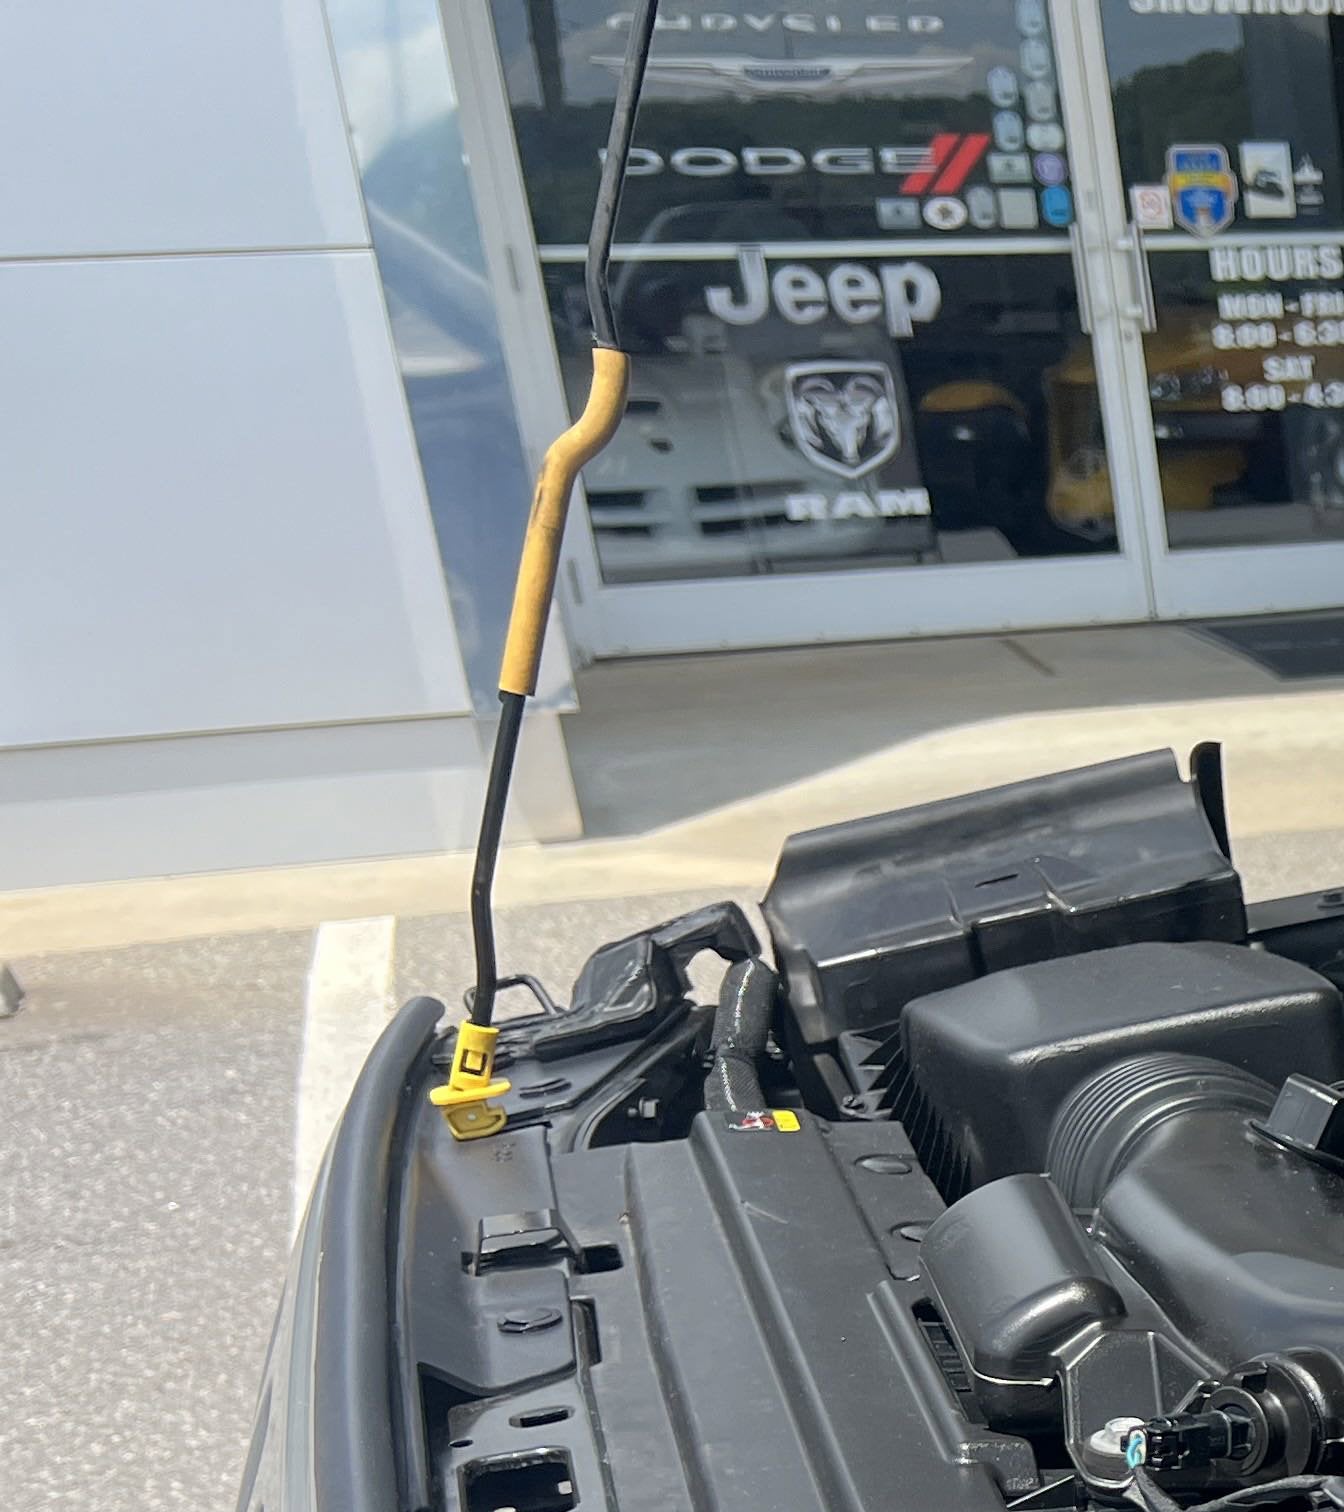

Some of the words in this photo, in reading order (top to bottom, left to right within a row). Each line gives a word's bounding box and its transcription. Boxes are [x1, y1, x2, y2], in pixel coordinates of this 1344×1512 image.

[598, 147, 938, 175] DODGE
[1208, 245, 1344, 282] HOURS
[705, 246, 942, 338] Jeep
[785, 488, 932, 521] RAM
